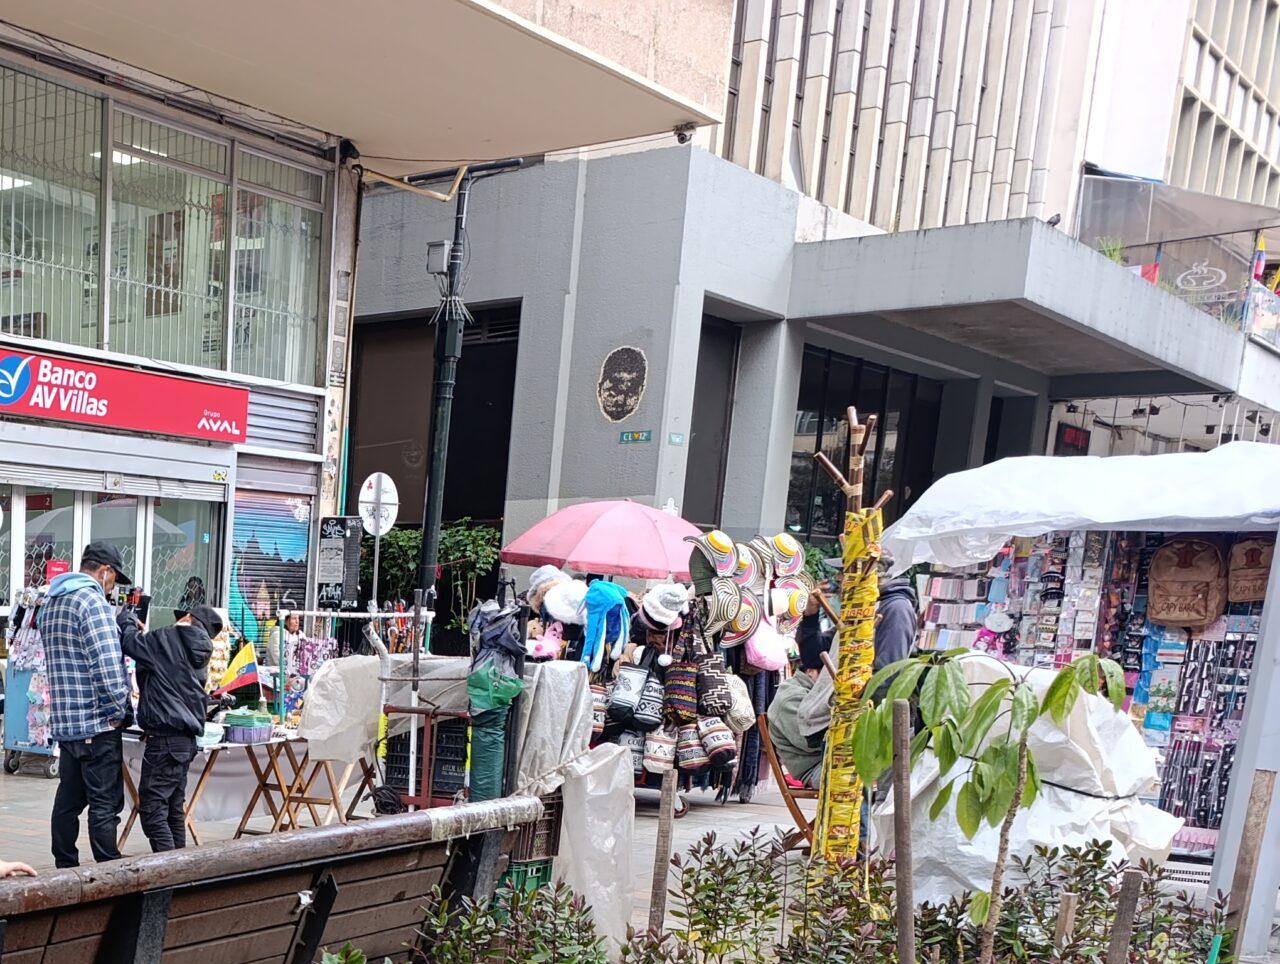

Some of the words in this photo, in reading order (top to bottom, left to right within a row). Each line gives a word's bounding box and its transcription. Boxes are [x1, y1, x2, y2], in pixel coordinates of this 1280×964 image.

[36, 358, 97, 391] Banco
[29, 384, 57, 409] AV
[57, 387, 108, 417] Villas
[203, 408, 221, 418] Grupo
[197, 417, 240, 435] AVAL
